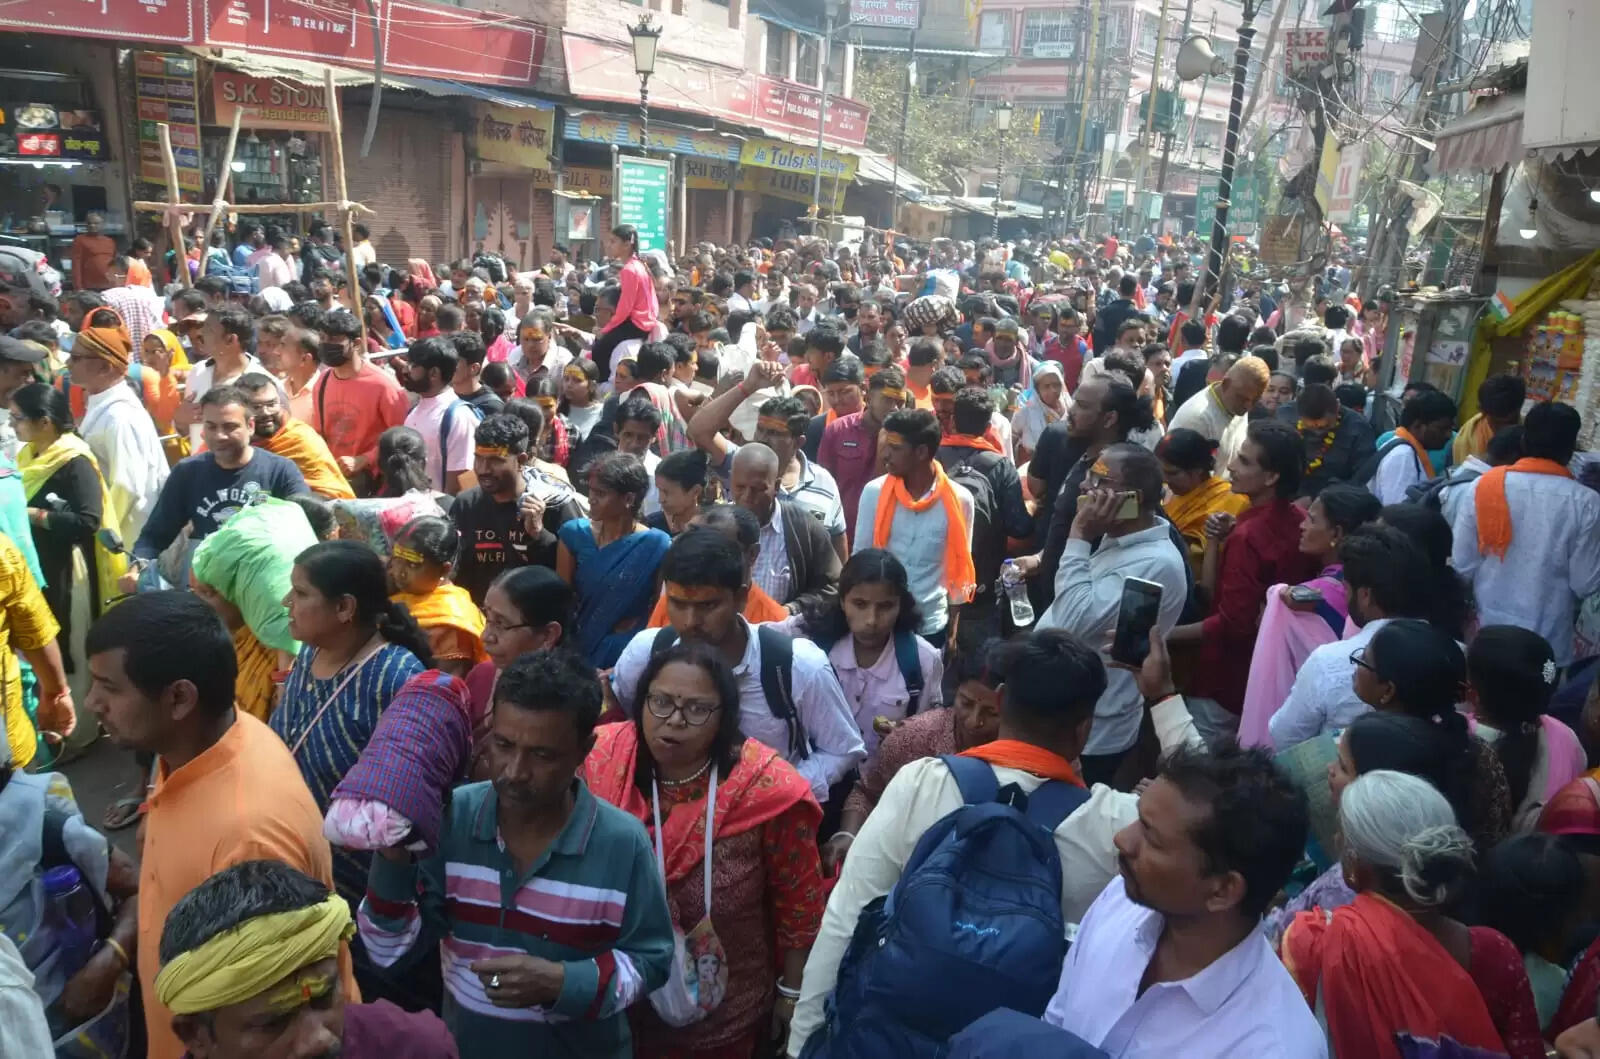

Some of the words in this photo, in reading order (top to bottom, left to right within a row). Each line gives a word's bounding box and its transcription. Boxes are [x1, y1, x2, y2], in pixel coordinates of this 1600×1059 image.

[223, 81, 264, 103] S.K.
[269, 86, 328, 107] STON
[771, 145, 805, 169] Tulsi
[475, 529, 496, 540] TO
[508, 529, 525, 542] MY
